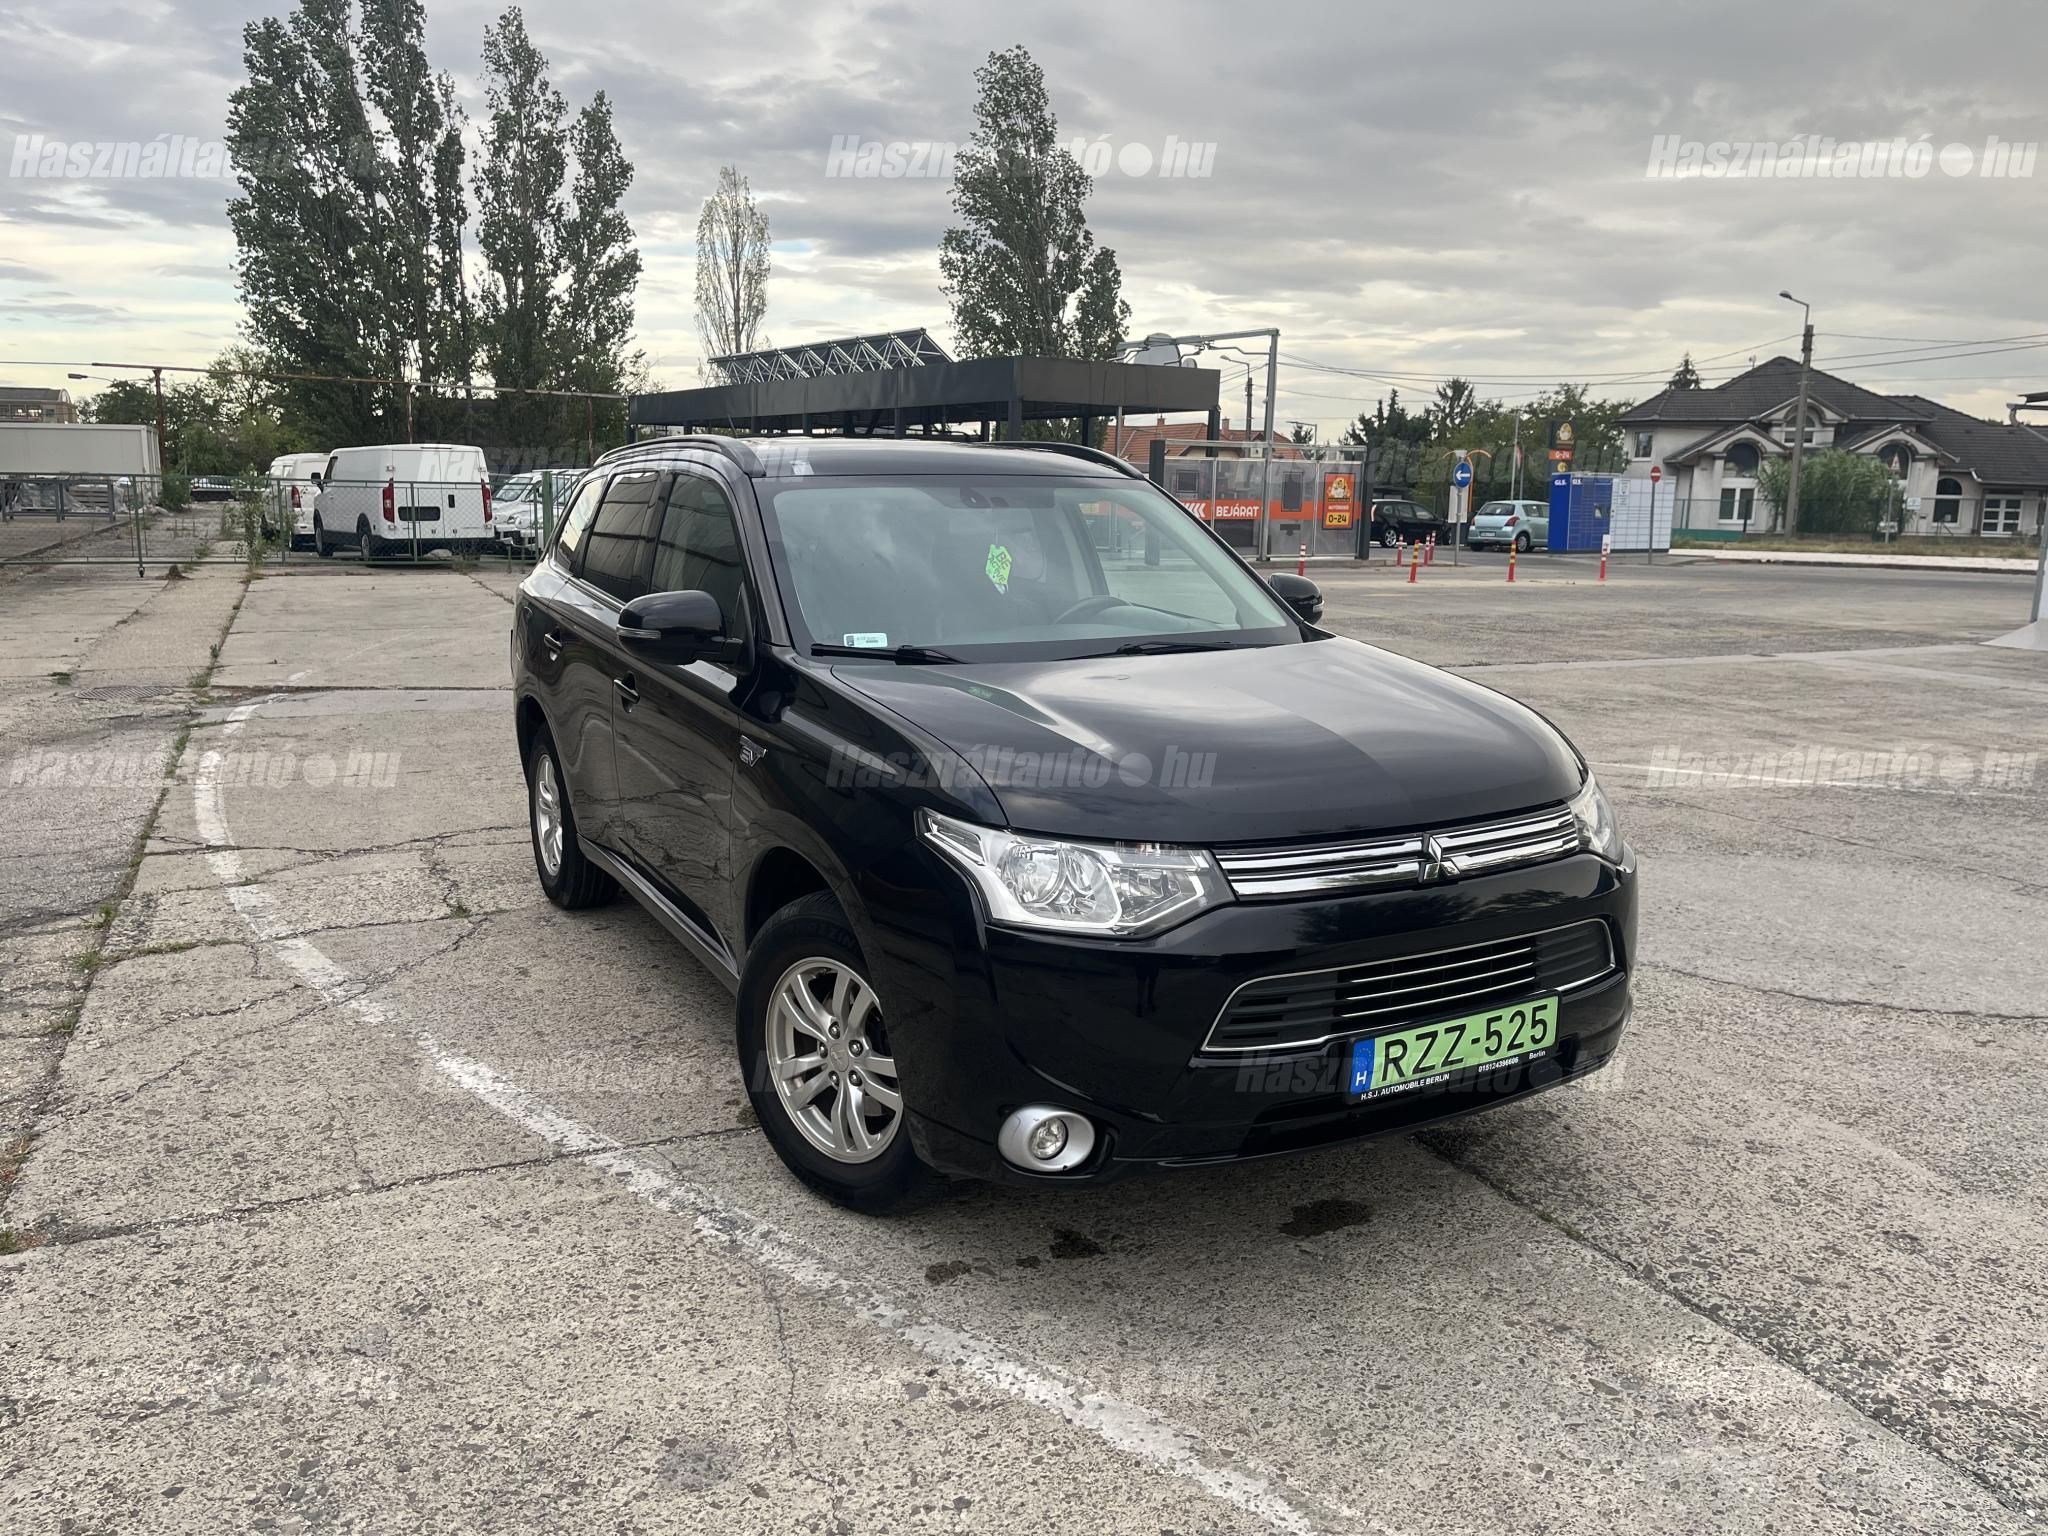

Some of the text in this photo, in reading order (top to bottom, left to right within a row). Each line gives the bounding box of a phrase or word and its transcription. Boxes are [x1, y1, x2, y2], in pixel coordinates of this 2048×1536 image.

[1215, 503, 1260, 517] BEJÁRAT
[1328, 514, 1347, 523] 0-24
[1381, 1003, 1549, 1082] RZZ-525
[1528, 1050, 1546, 1060] Berlin
[1355, 1070, 1368, 1087] H
[1381, 1079, 1425, 1096] AUTOMOBILE
[1426, 1073, 1450, 1085] BERLIN
